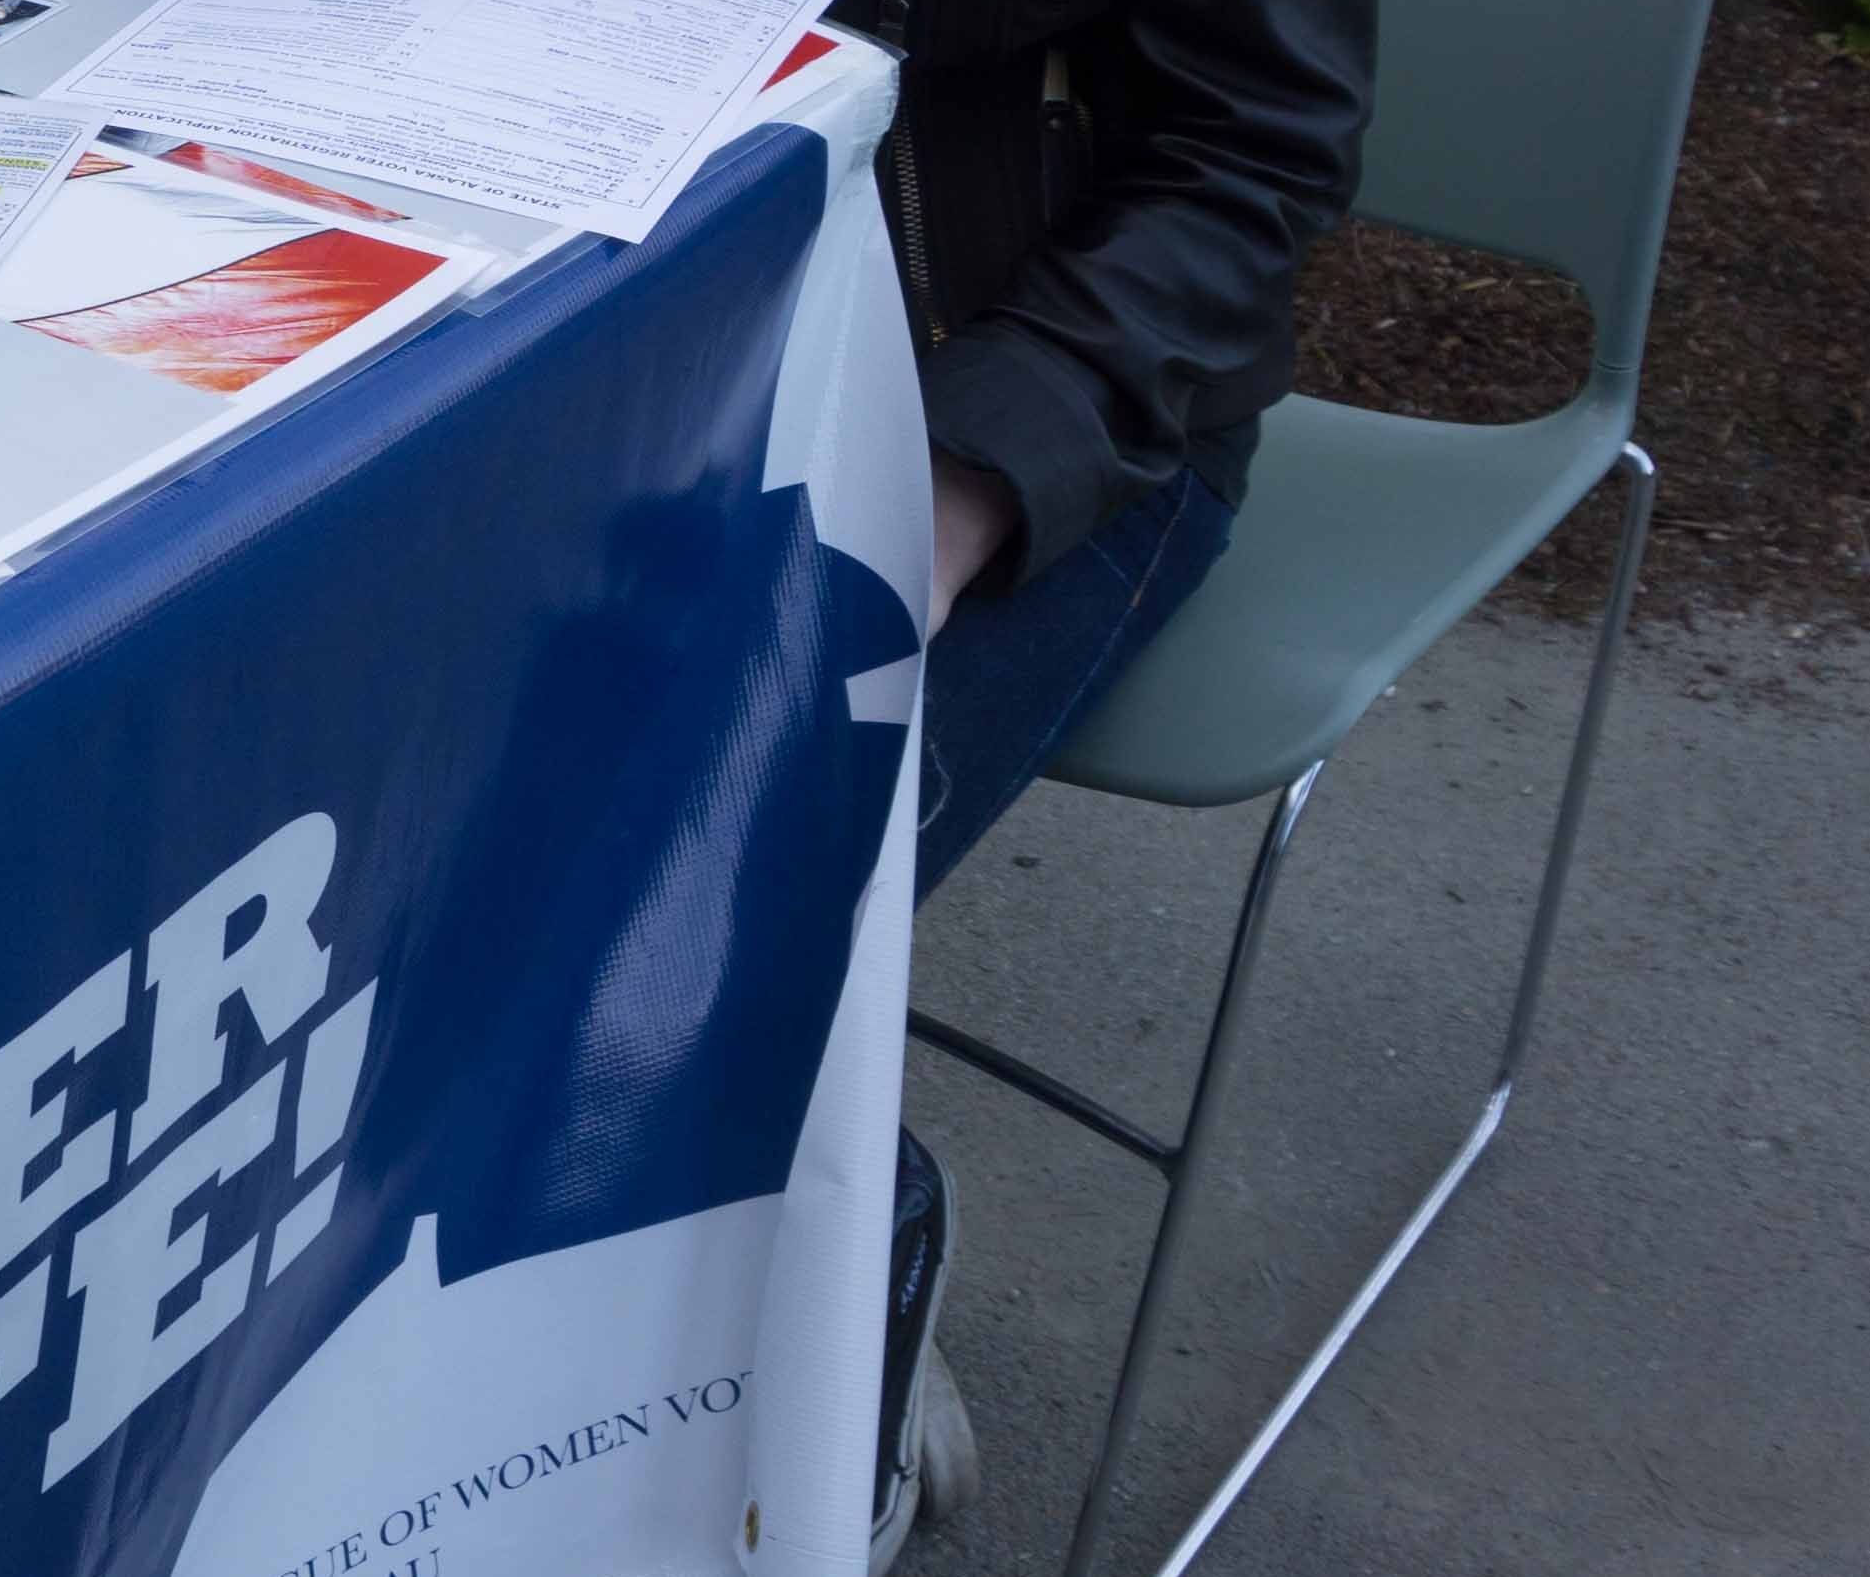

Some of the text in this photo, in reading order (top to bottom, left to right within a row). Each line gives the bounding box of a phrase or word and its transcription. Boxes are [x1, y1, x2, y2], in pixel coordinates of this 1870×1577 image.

[114, 109, 561, 209] STATE OF ALASKA VOTER REGISTRATION APPLICATION
[378, 1493, 442, 1546] OF
[452, 1404, 651, 1511] WOMEN
[664, 1371, 755, 1423] VO
